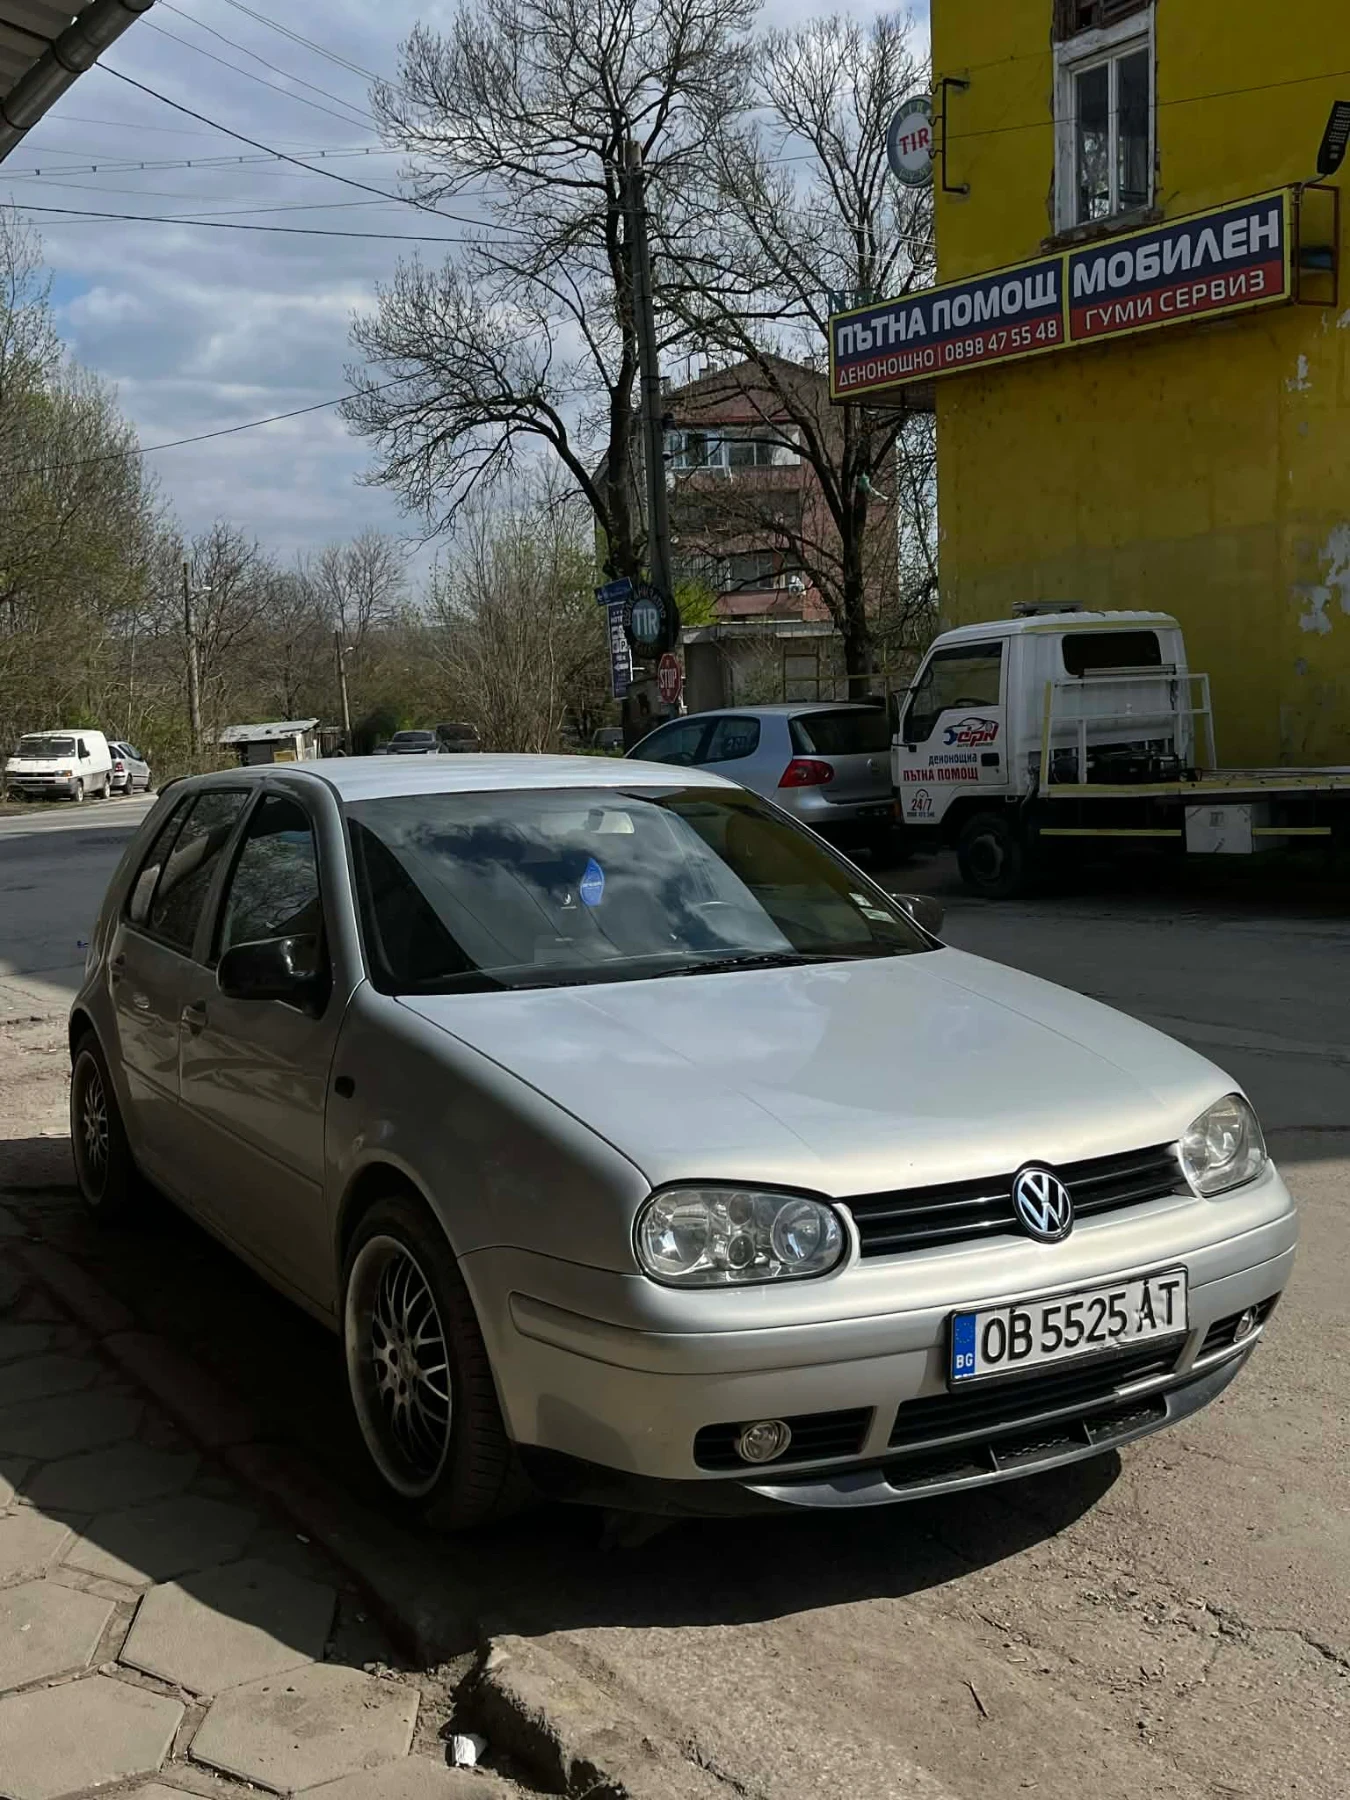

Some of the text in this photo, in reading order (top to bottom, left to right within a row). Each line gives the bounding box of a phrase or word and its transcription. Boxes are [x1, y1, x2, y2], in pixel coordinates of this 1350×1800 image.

[899, 127, 930, 156] TIR
[1073, 209, 1279, 298] МОБИЛЕН
[837, 271, 1057, 357] ПЪТНА ПОМОЩ
[1085, 270, 1265, 331] ГУМИ СЕРВИЗ
[839, 320, 1057, 386] ДЕНОНОЩНО 0898 47 55 48
[633, 609, 658, 635] TIR
[660, 668, 677, 689] STOP
[903, 767, 979, 781] ПЪТНА ПОМОЩ
[911, 798, 932, 811] 24/7
[981, 1281, 1180, 1365] OB 5525 AT
[956, 1352, 974, 1369] BG
